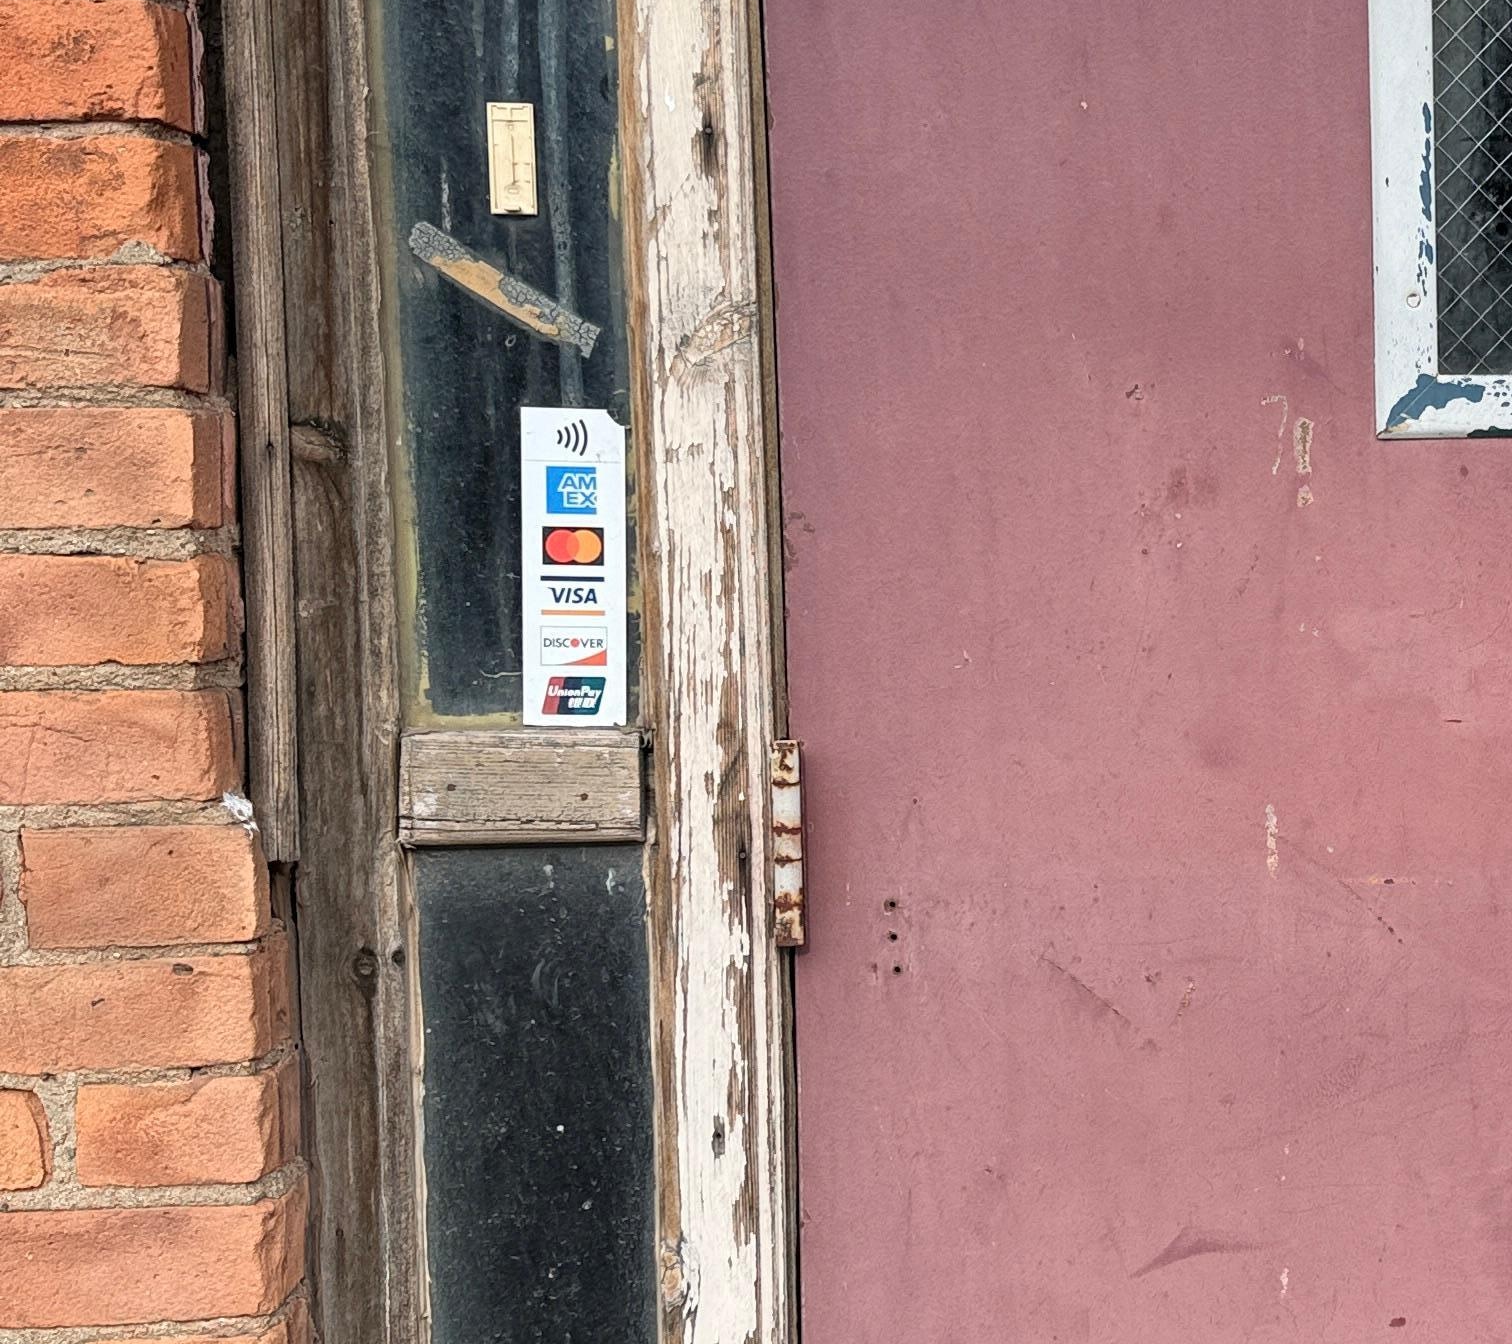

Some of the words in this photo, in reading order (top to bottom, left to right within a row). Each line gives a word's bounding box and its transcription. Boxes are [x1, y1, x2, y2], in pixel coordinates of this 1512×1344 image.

[561, 475, 597, 490] AM
[566, 492, 597, 505] EX
[548, 587, 598, 605] VISA
[543, 637, 604, 649] DISCOVER
[547, 685, 602, 702] UnionPay
